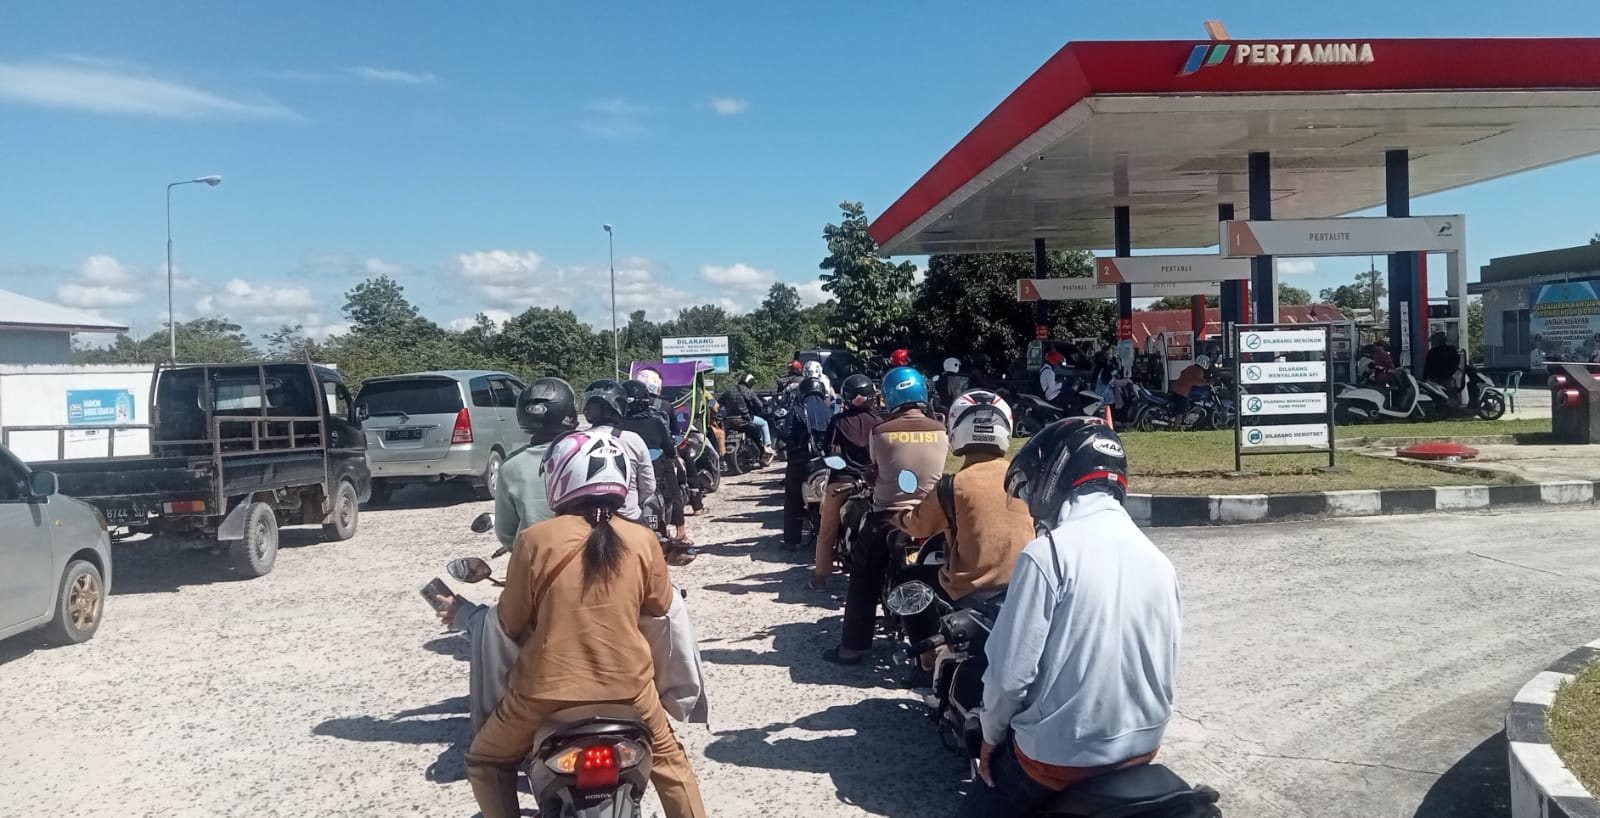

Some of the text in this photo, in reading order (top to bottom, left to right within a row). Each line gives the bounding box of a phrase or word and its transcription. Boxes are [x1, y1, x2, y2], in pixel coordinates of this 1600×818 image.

[1236, 43, 1375, 64] PERTAMINA
[1236, 232, 1351, 247] 1 PERTALITE
[1103, 265, 1193, 275] 2 PERTAMAX
[888, 431, 939, 444] POLISI
